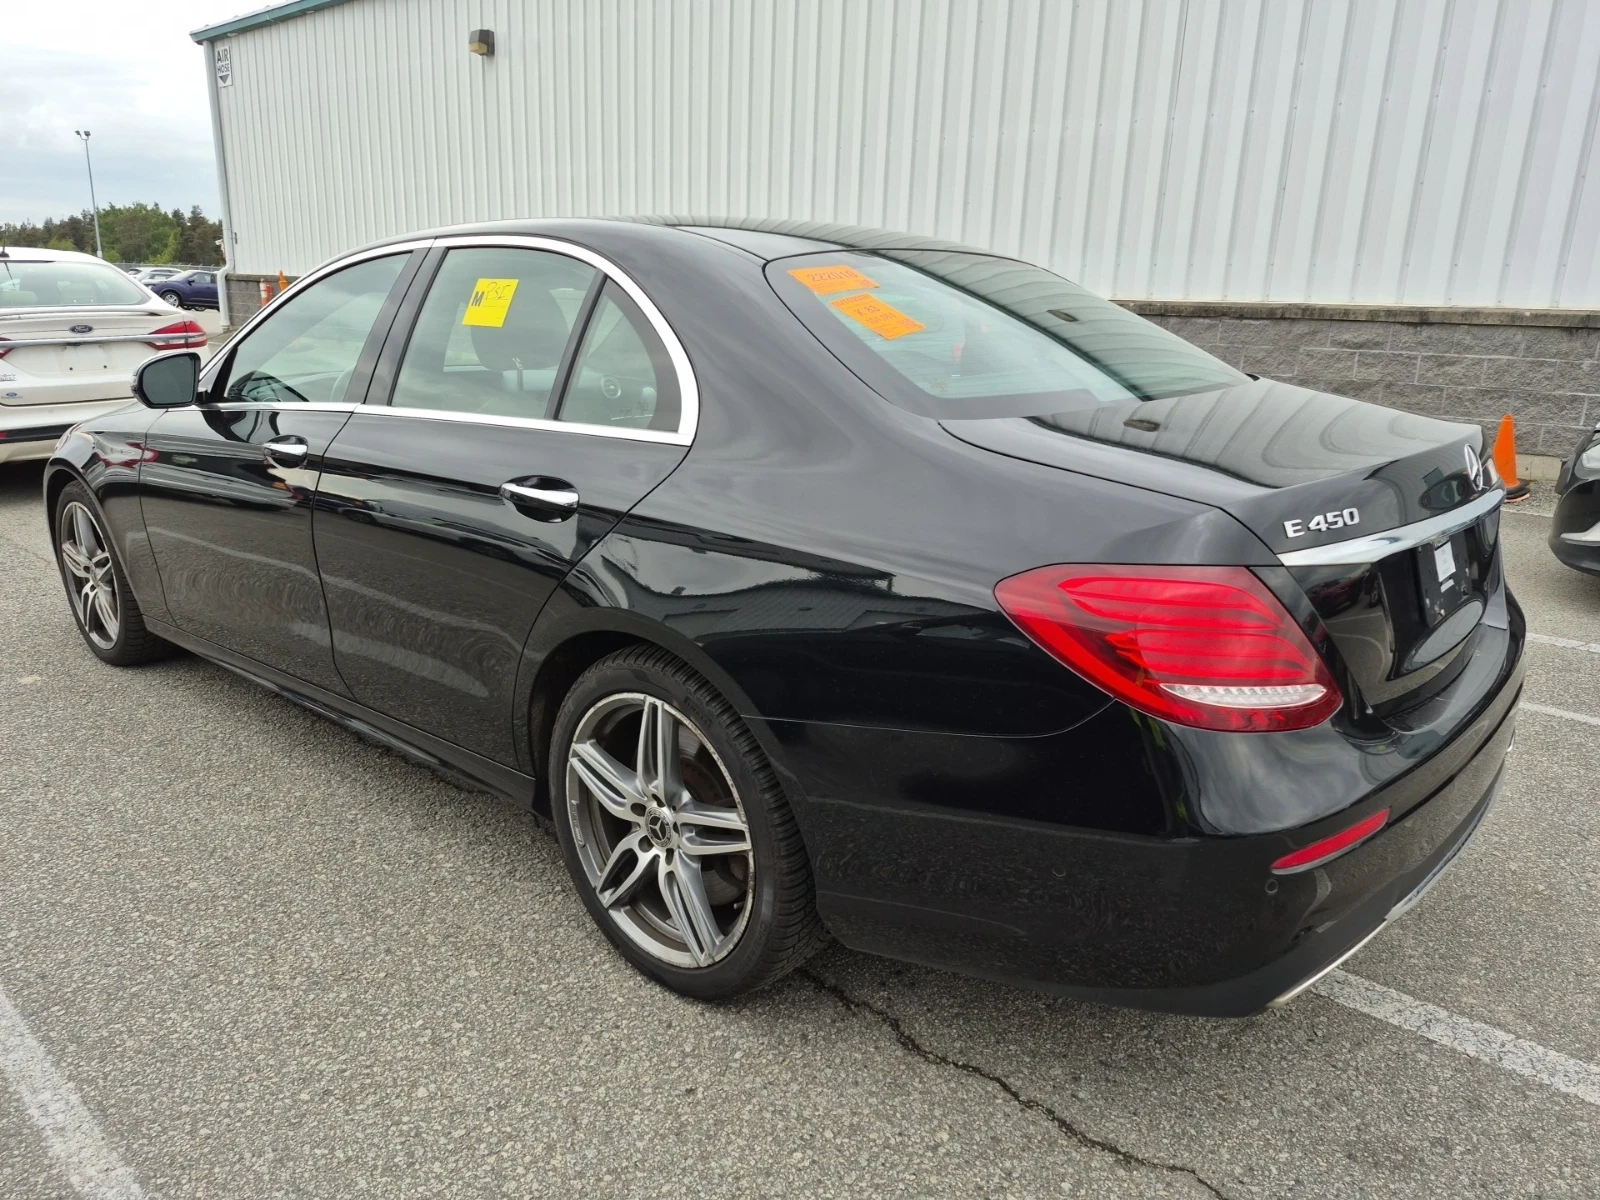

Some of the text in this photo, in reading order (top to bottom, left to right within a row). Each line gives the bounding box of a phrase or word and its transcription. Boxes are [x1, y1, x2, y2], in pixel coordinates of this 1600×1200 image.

[217, 48, 229, 63] AIR
[471, 291, 485, 307] M
[1283, 507, 1360, 538] E 450
